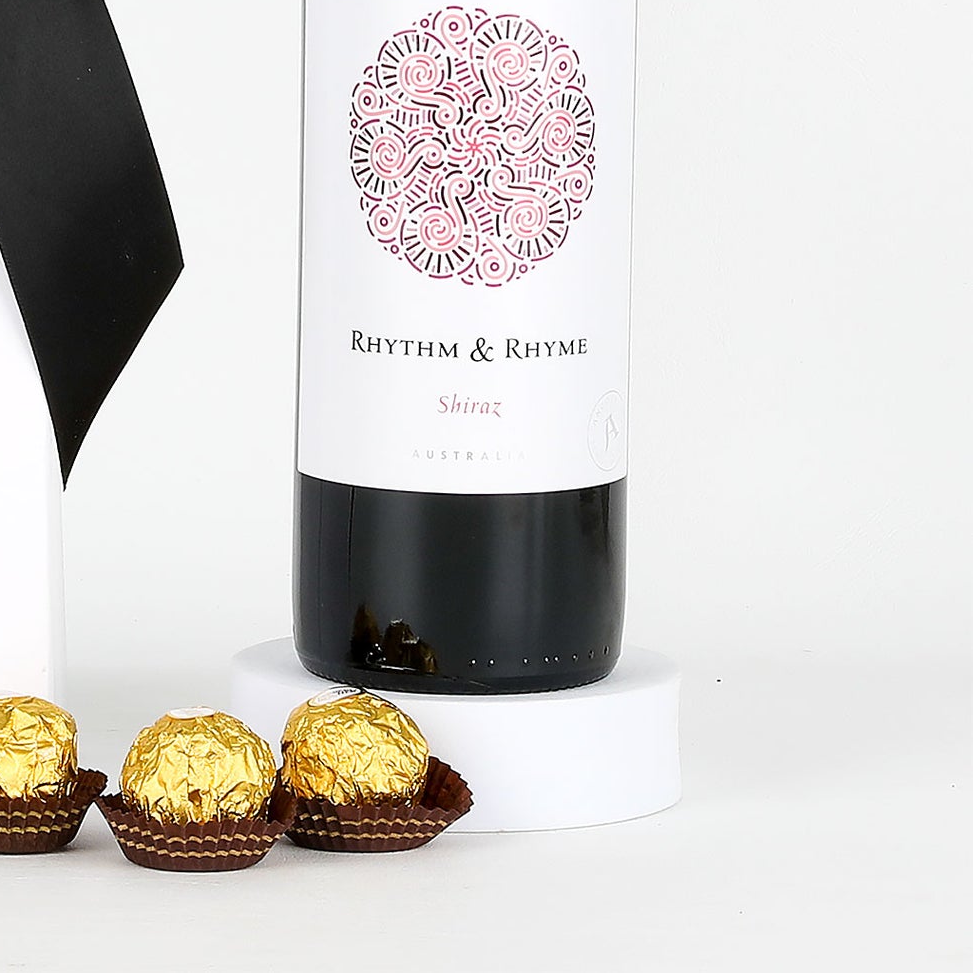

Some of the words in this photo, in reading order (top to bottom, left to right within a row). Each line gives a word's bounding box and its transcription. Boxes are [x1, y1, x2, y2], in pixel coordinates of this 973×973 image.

[351, 329, 459, 359] RHYTHM
[469, 336, 495, 363] &
[505, 337, 588, 360] RHYME
[436, 393, 503, 418] Shiraz
